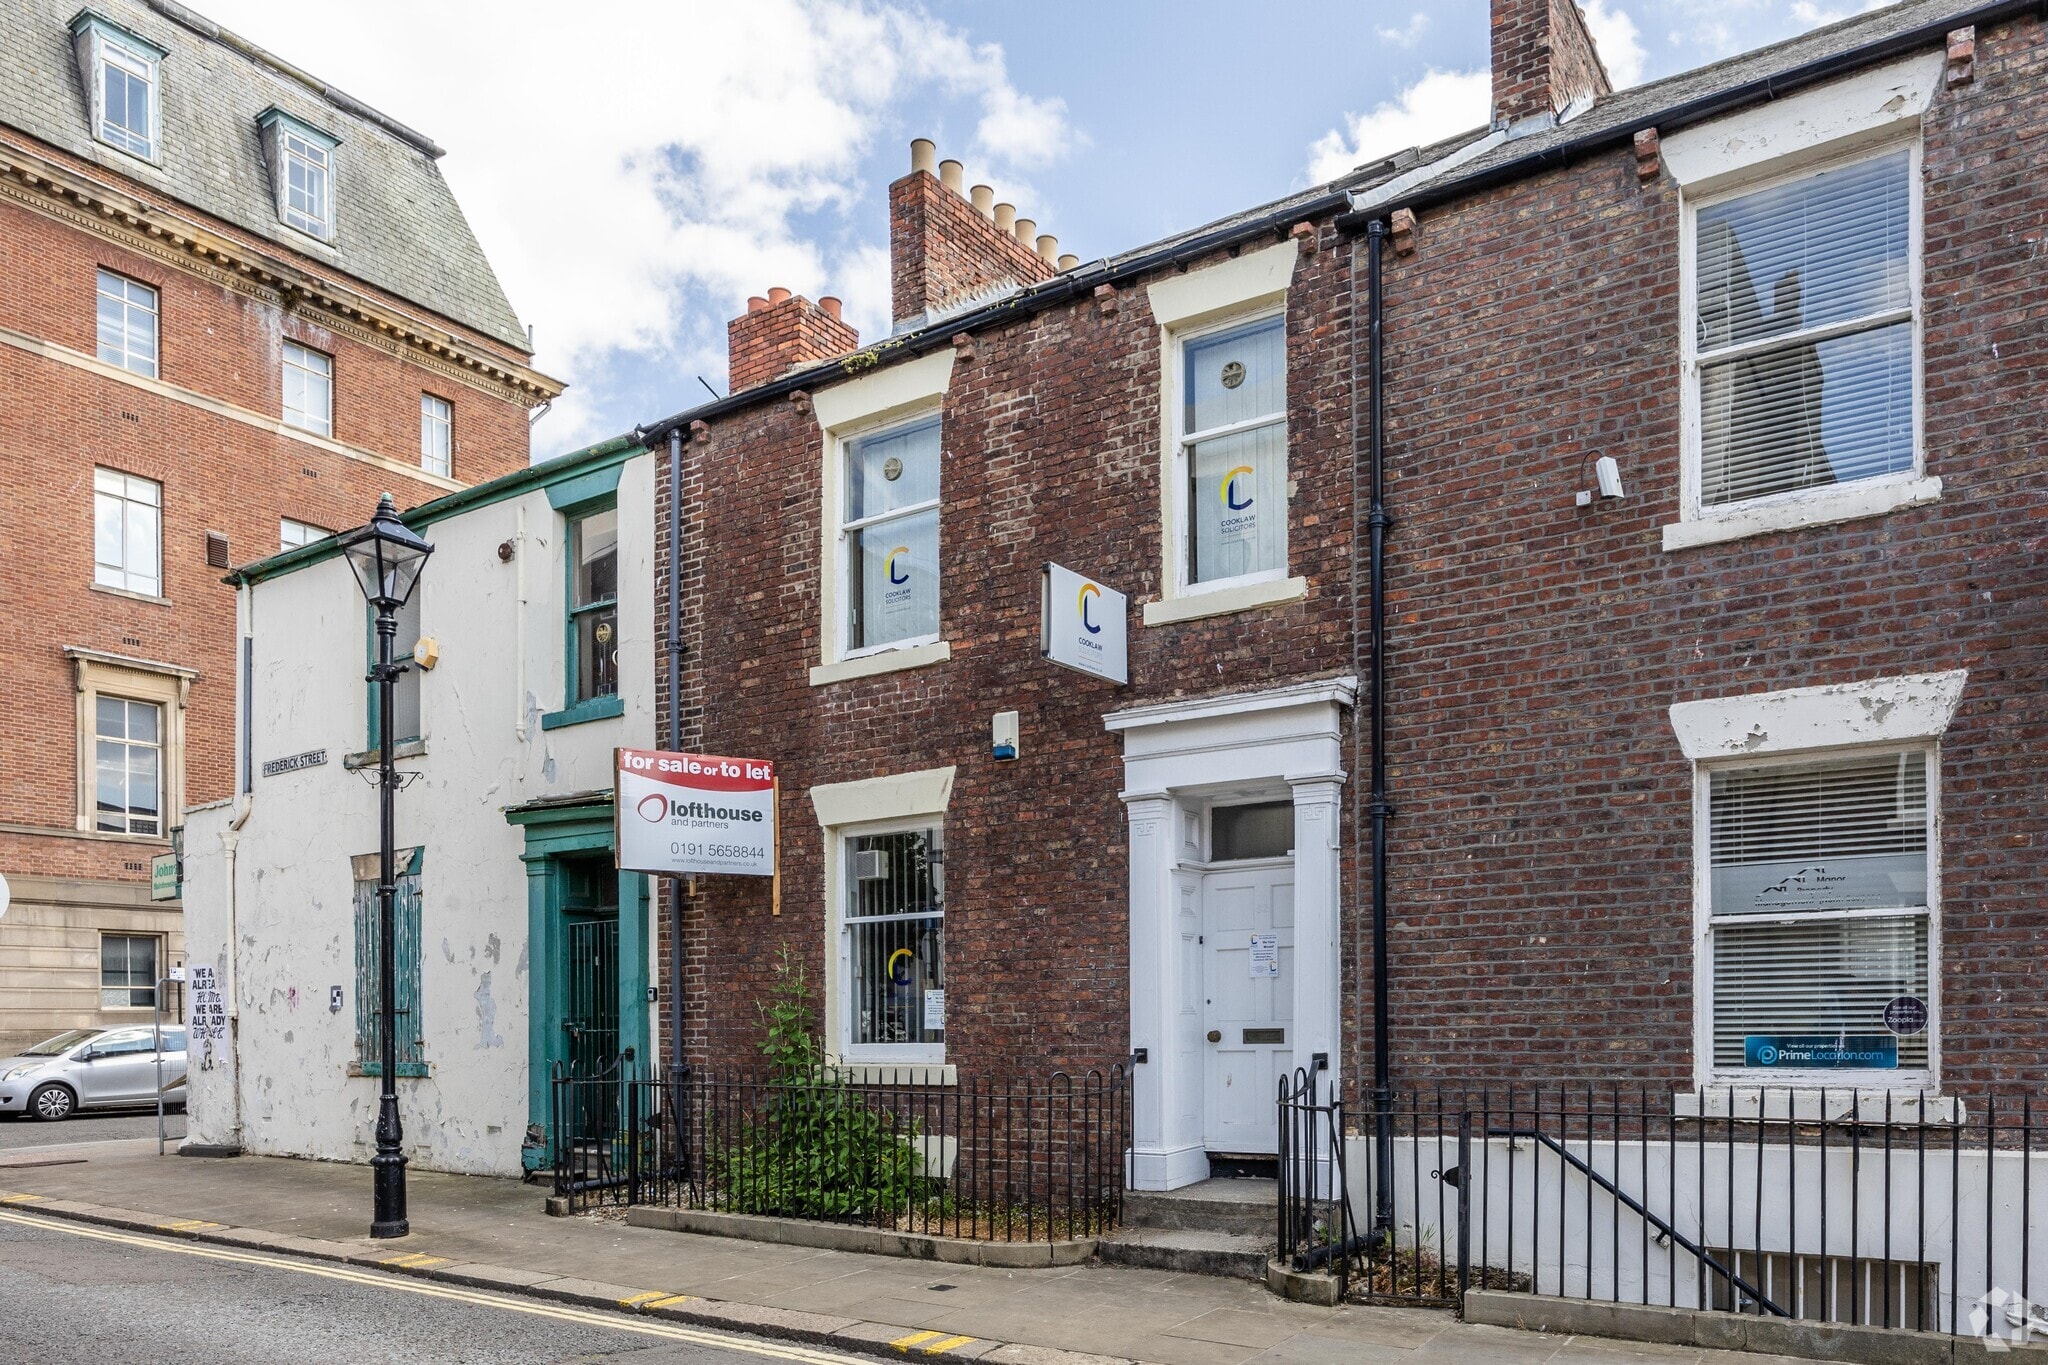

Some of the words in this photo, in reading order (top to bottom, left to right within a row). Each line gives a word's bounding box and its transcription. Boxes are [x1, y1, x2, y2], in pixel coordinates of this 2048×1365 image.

[1220, 514, 1256, 527] COOKLAW
[1220, 522, 1256, 534] SOLICITORS
[885, 588, 912, 599] COOKLAW
[885, 594, 912, 605] SOLICITORS
[1078, 636, 1103, 651] COOKLAW
[263, 757, 299, 775] FREDERICK
[299, 751, 326, 767] STREET
[623, 751, 654, 770] for
[658, 757, 702, 775] sale
[703, 766, 718, 776] or
[720, 761, 741, 778] to
[746, 763, 771, 780] let
[670, 800, 763, 822] lofthouse
[671, 818, 689, 827] and
[691, 820, 729, 830] partners
[670, 841, 703, 856] 0191
[708, 844, 765, 859] 5658844
[671, 858, 758, 867] www.lofthouseandpartners.co.uk
[195, 1004, 207, 1015] WE
[192, 1015, 226, 1026] ALRADY
[1778, 1049, 1884, 1060] PrimeLocation.com
